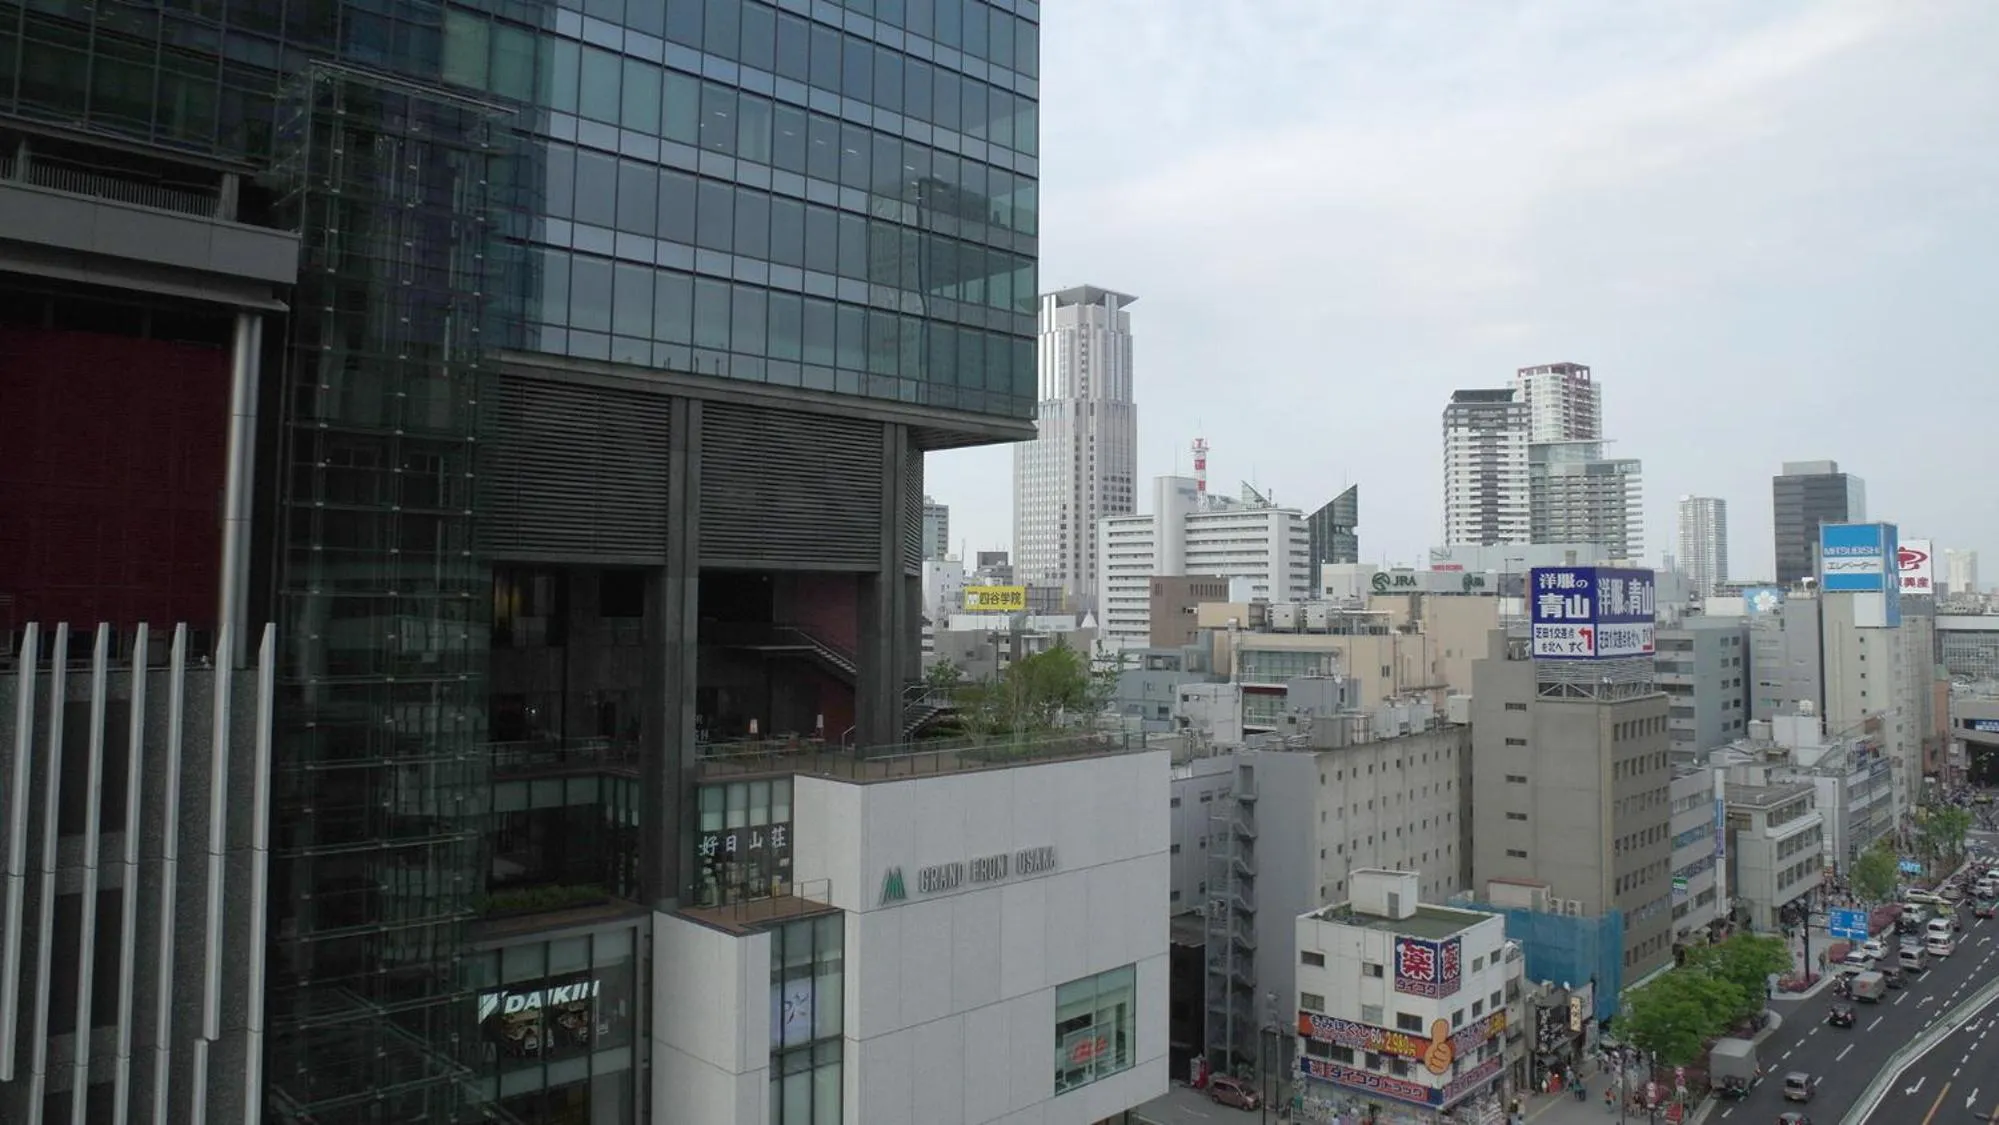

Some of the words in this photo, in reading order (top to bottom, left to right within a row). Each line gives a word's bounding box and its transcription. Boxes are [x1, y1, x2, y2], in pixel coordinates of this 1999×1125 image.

[1392, 575, 1417, 586] JRA
[1539, 573, 1588, 589] 洋服の
[980, 592, 1022, 605] 四谷学院
[1538, 593, 1590, 619] 青山
[1597, 578, 1654, 616] 洋服の青山
[699, 826, 787, 857] 好日山荘
[919, 863, 963, 893] GRAND
[970, 854, 1008, 883] FRONT
[1016, 846, 1056, 874] OSAKA
[1400, 940, 1434, 981] 薬
[504, 980, 600, 1014] DAIKIN
